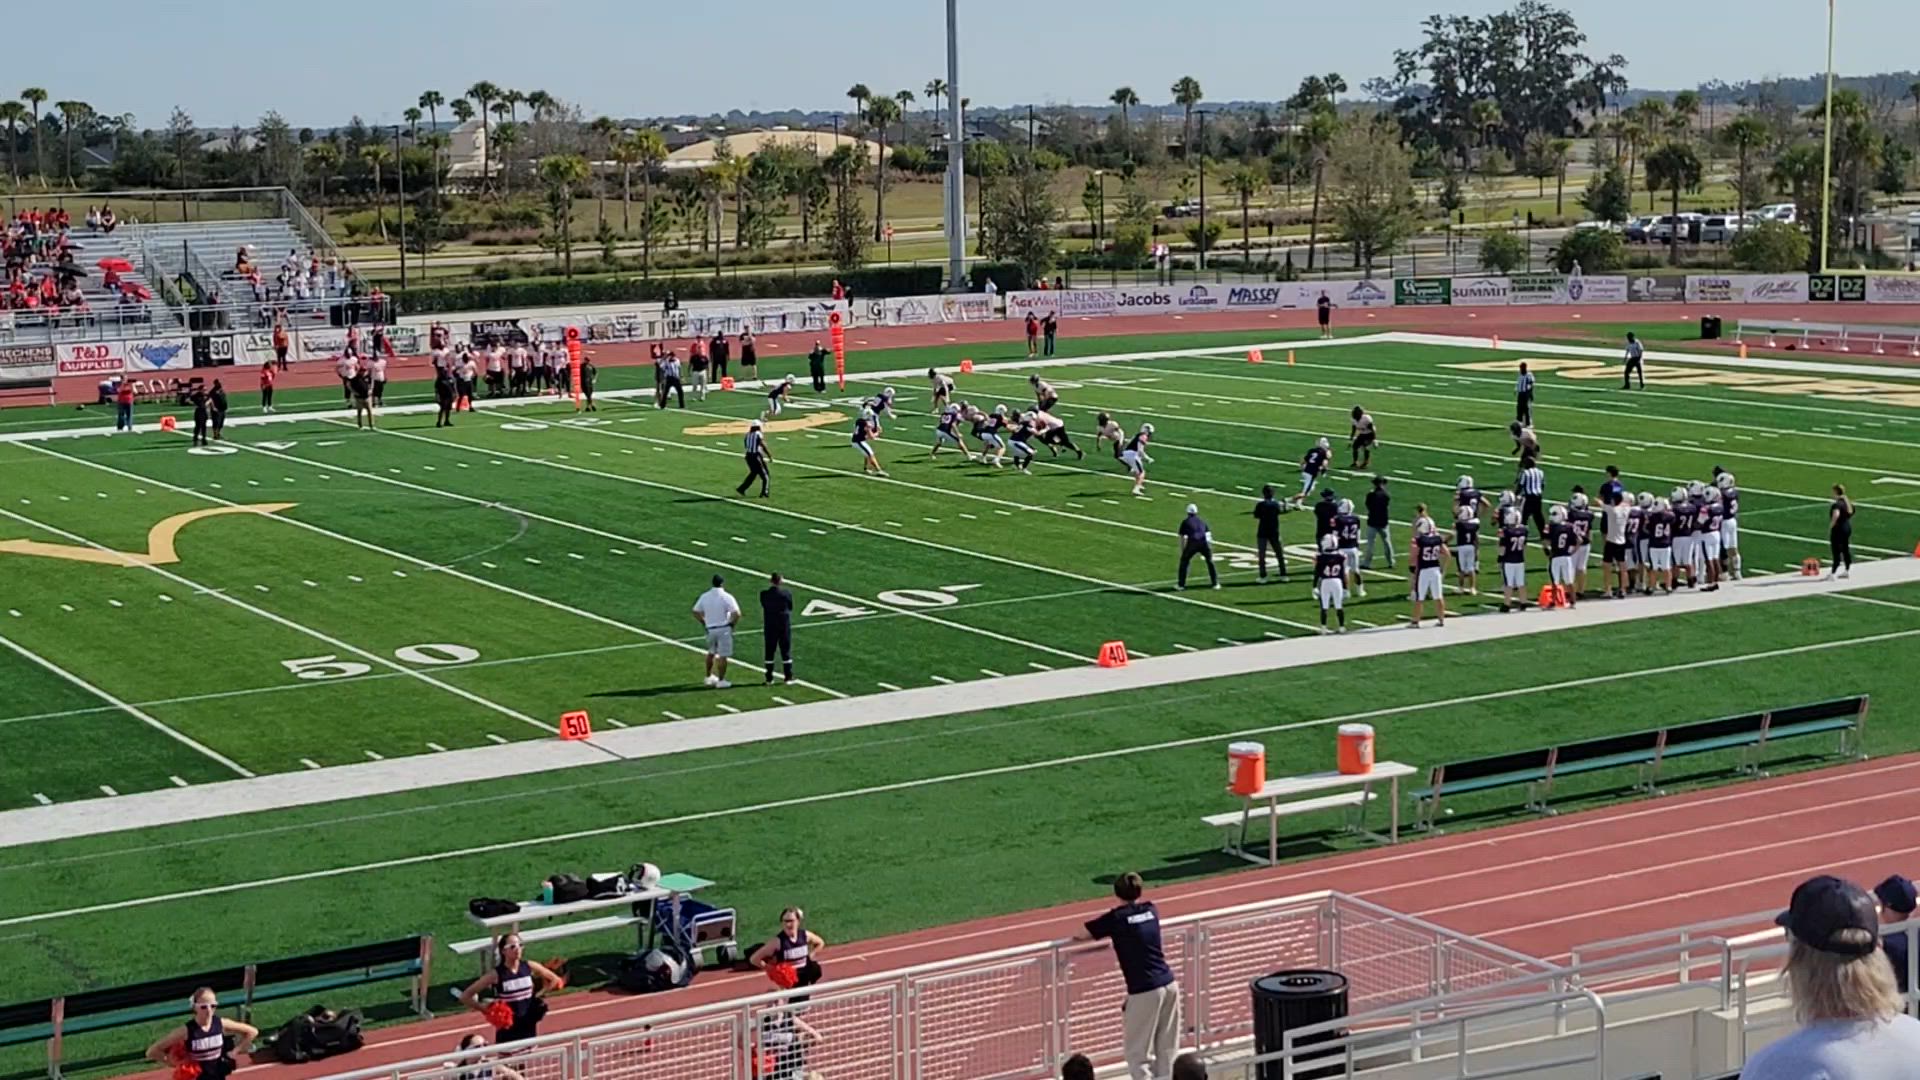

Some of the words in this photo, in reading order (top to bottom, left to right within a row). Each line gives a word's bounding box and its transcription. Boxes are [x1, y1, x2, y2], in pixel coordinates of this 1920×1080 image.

[1117, 292, 1171, 306] Jacobs
[1227, 287, 1280, 303] MASSEY
[1452, 287, 1507, 298] SUMMIT
[871, 302, 882, 317] G
[72, 345, 109, 360] T&D
[211, 340, 231, 356] 30
[63, 360, 120, 372] SUPPLIES
[1558, 533, 1568, 549] 6
[801, 588, 959, 618] 40
[281, 643, 481, 680] 50
[1109, 645, 1125, 664] 40
[565, 715, 589, 738] 50
